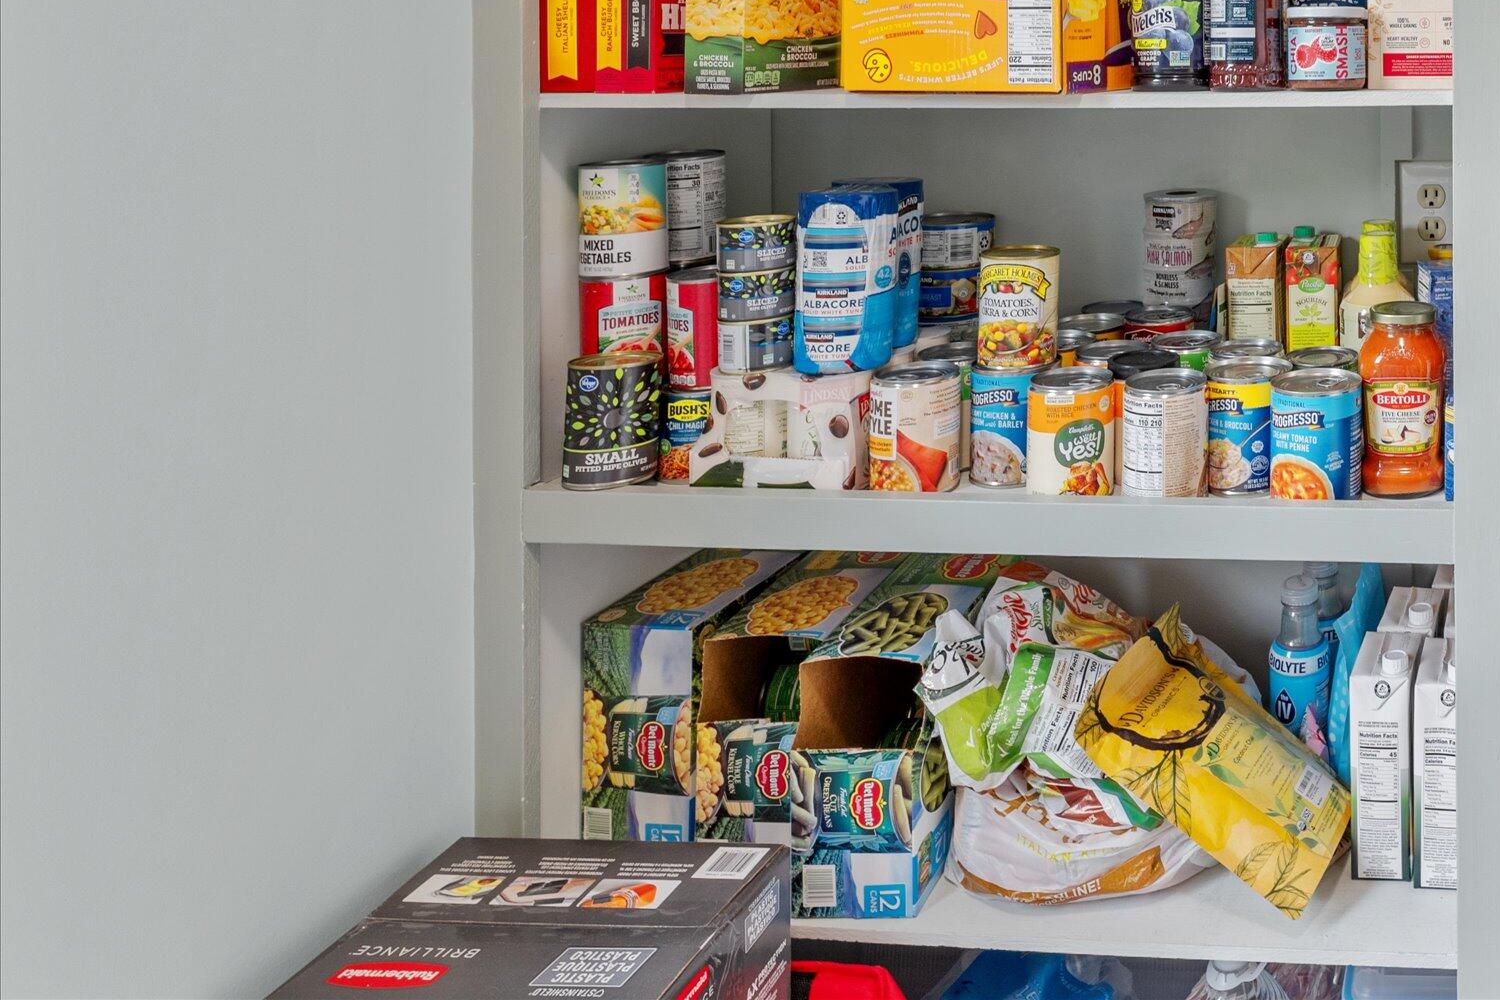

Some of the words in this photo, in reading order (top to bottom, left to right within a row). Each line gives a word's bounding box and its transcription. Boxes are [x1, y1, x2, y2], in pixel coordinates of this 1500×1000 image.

[1131, 7, 1176, 35] Welch's
[786, 46, 813, 54] CHICKEN
[1336, 25, 1349, 80] SMASH
[699, 54, 728, 62] CHICKEN
[584, 239, 613, 251] MIXED
[757, 247, 786, 257] SLICED
[747, 296, 779, 307] SLICED
[804, 299, 863, 308] ALBACORE
[984, 298, 1034, 309] TOMATOES,
[982, 307, 1000, 318] OKRA
[1002, 307, 1010, 316] &
[1013, 306, 1038, 316] CORN
[602, 311, 659, 331] TOMATOES
[1377, 395, 1426, 404] BERTOLLI
[670, 403, 708, 415] BUSH'S
[1272, 413, 1319, 427] PROGRESSO
[1226, 422, 1253, 432] BROCCOLI
[1059, 430, 1102, 461] Yes!
[585, 449, 639, 465] SMALL
[622, 457, 648, 469] OLIVES
[1270, 653, 1306, 674] BIOLYTE
[647, 737, 657, 767] monte
[770, 765, 779, 797] monte
[864, 795, 874, 826] monte
[869, 889, 877, 912] CANS
[878, 889, 900, 912] 12
[354, 944, 481, 959] BRILLIANCE
[553, 961, 633, 972] PLASTIQUE
[338, 968, 441, 981] Rubbermaid
[550, 972, 613, 984] PLASTIC
